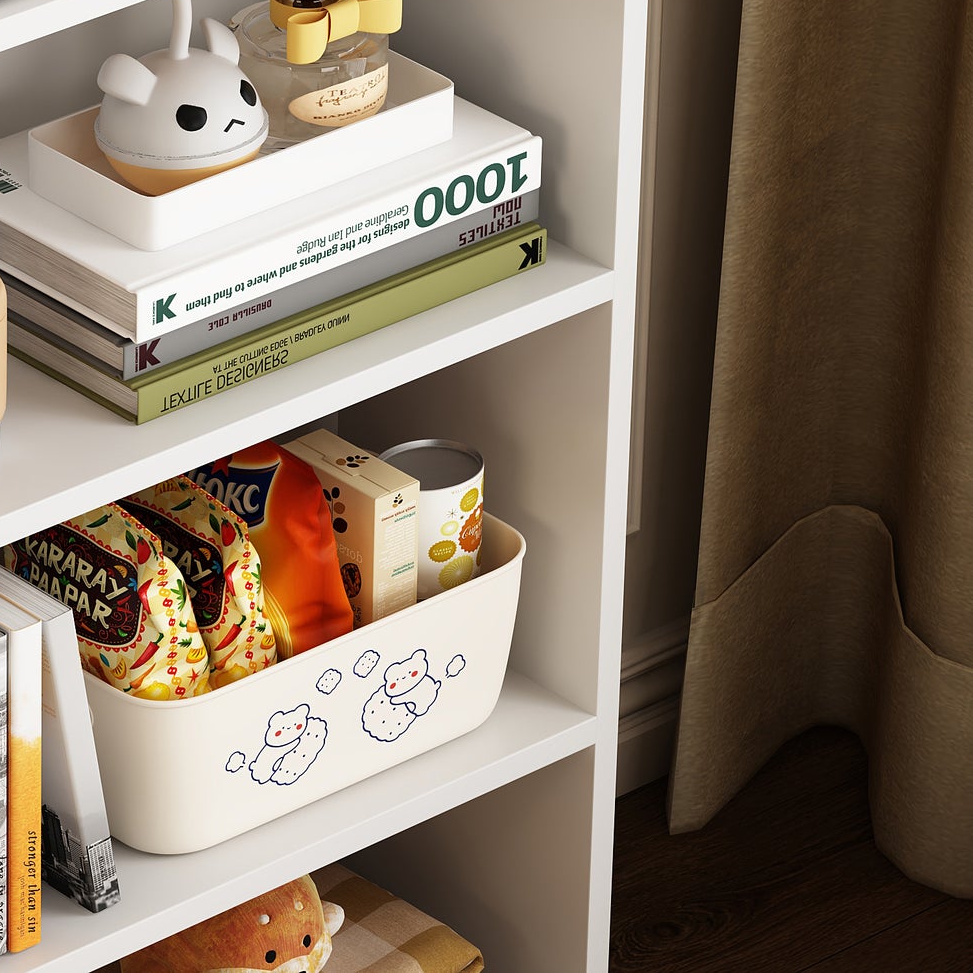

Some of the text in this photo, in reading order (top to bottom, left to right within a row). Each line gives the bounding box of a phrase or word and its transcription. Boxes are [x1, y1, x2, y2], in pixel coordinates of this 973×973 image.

[414, 151, 528, 228] 1000
[296, 204, 409, 254] Geraldine and Ian Rudge
[458, 212, 521, 246] TEXTILES
[185, 218, 410, 312] designs for the gardens and where to find them
[208, 299, 272, 331] DRUSILLA COLE
[25, 537, 129, 601] KARARAY
[23, 830, 40, 933] stronger than sin
